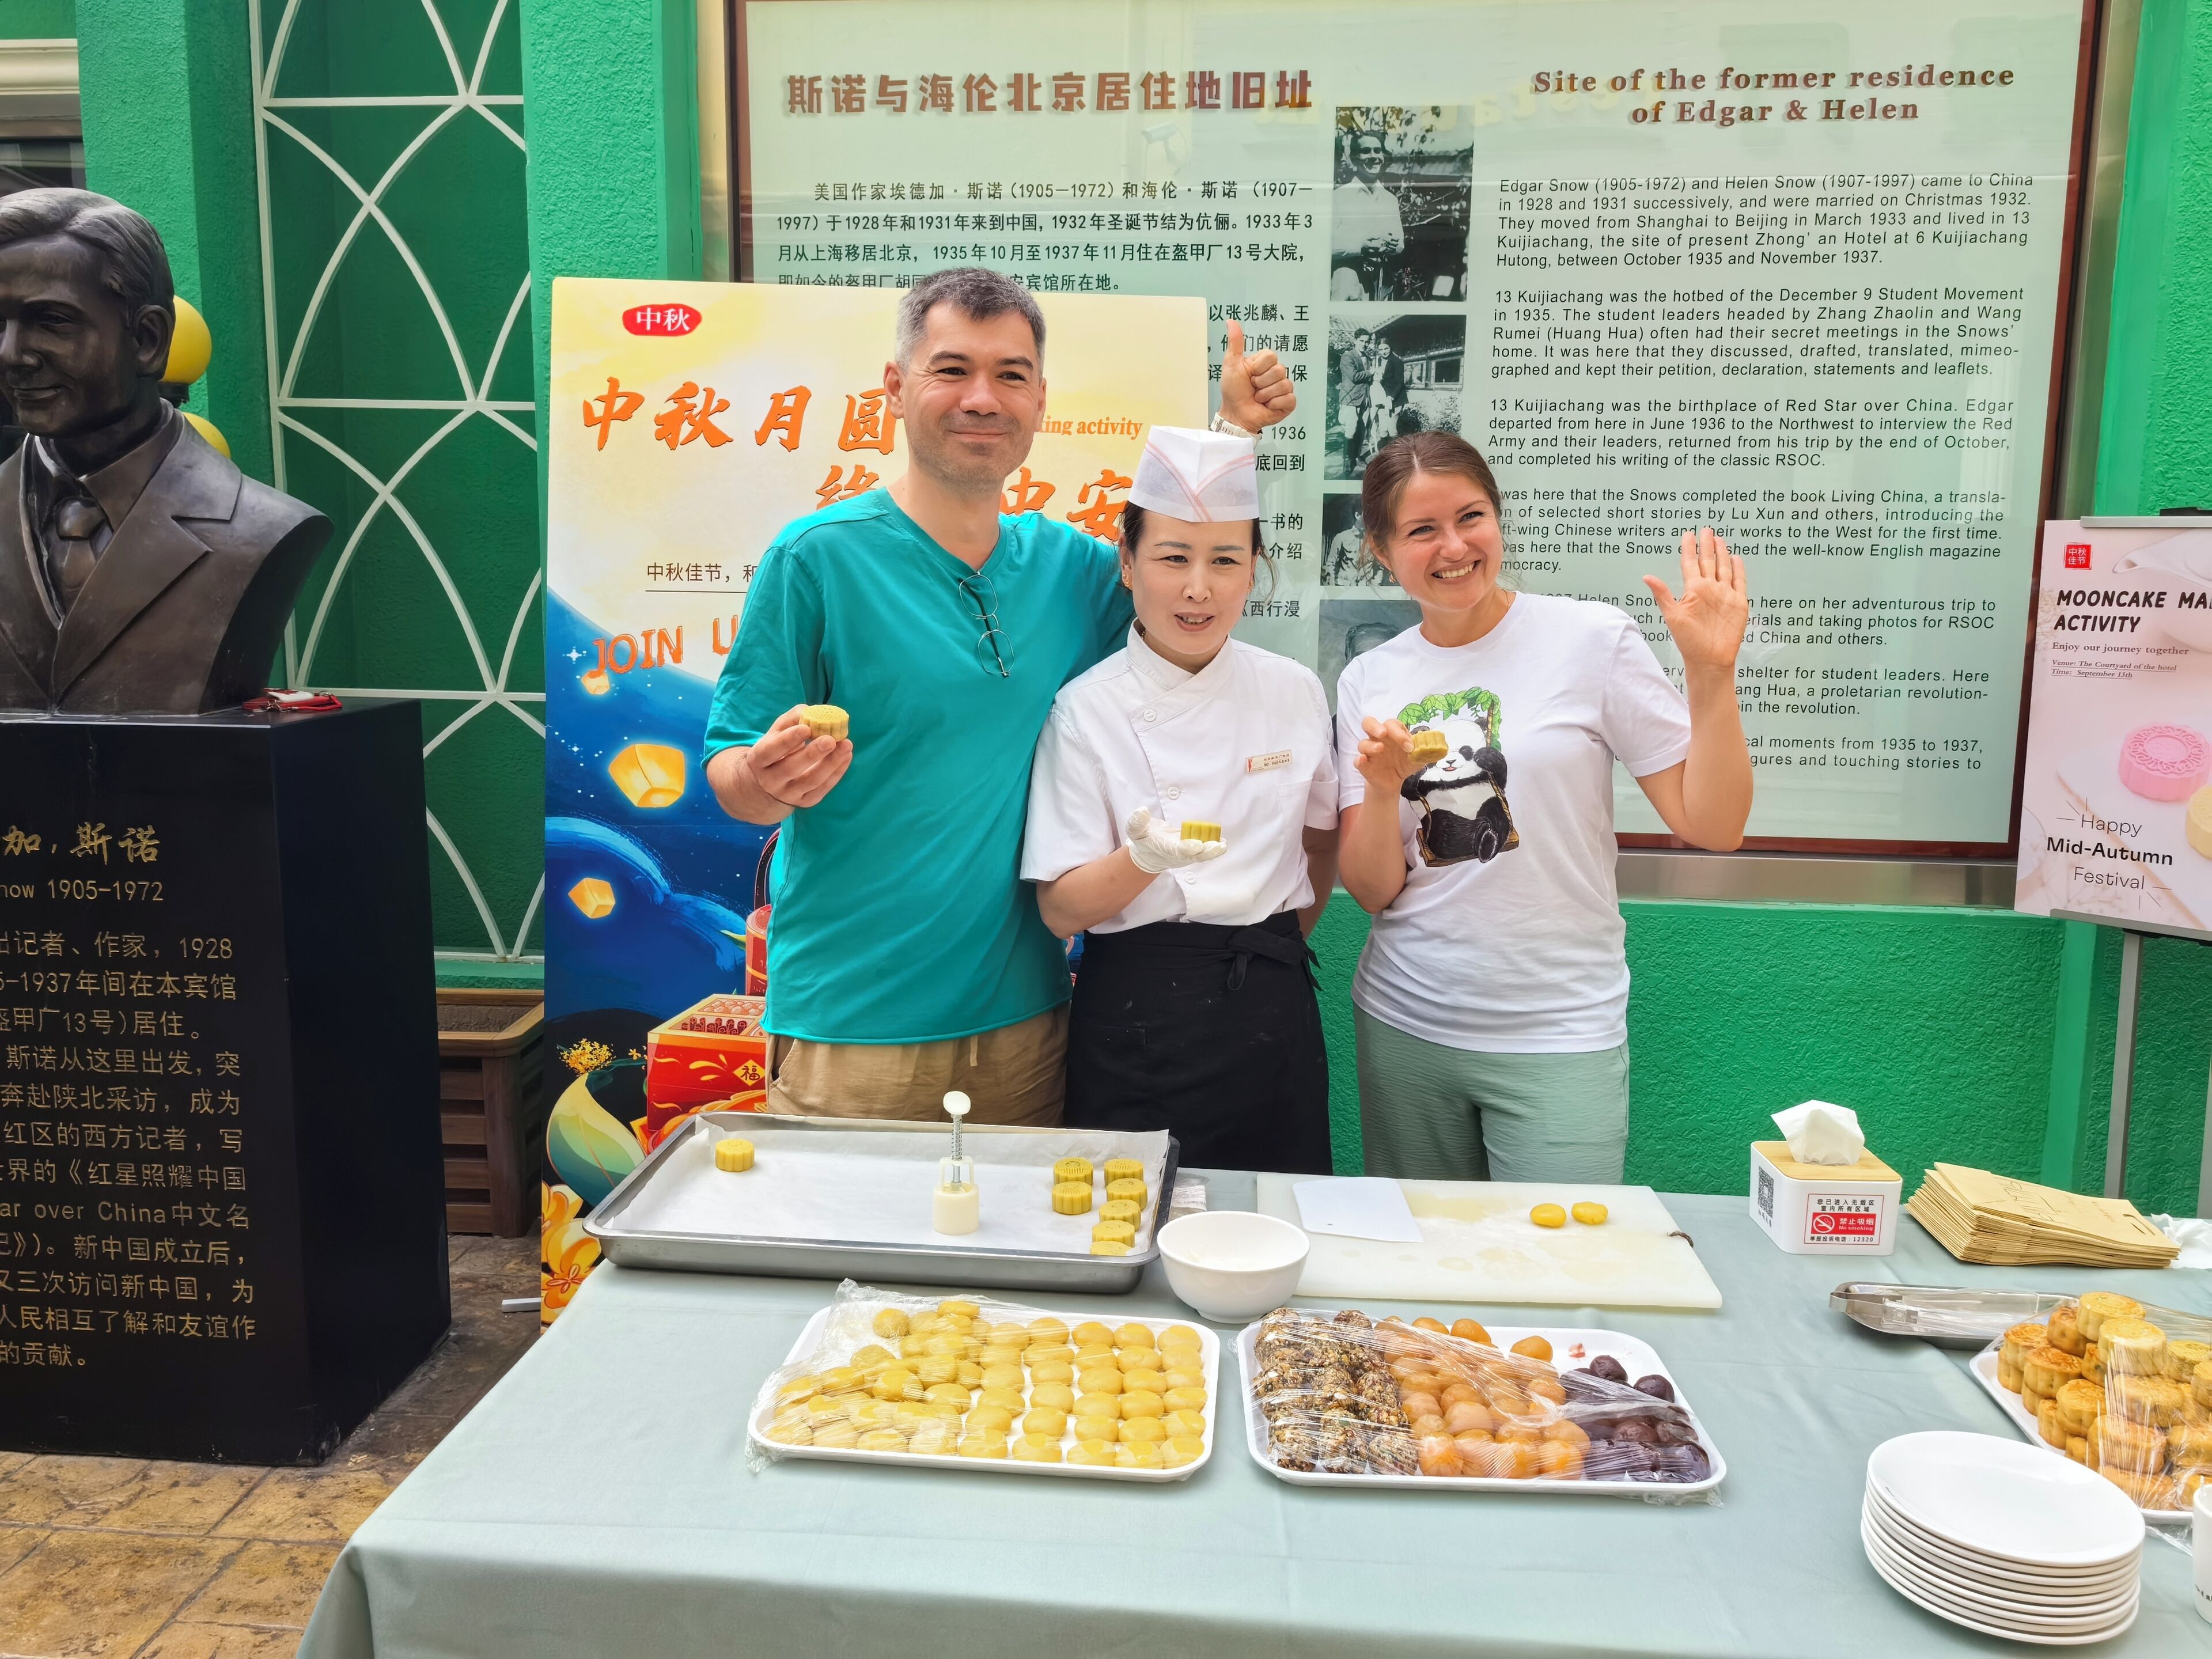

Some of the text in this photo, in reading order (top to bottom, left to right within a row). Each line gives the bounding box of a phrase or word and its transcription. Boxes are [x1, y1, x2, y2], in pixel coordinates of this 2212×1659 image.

[1535, 64, 2013, 92] Site of the former residence
[788, 70, 1312, 113] 斯诺与海伦北京居住地旧址
[1633, 101, 1665, 123] of
[1676, 100, 1772, 127] Edgar
[1787, 100, 1807, 120] &
[1821, 98, 1918, 119] Helen
[1501, 173, 2032, 195] Edgar Snow (1905-1972) and Helen Snow (1907-1997) came to China
[1499, 192, 2031, 211] in 1928 and 1931 successively, and were married on Christmas 1932.
[1496, 287, 2023, 306] 13 Kuijiachang was the hotbed of the December 9 Student Movement
[635, 305, 691, 332] 中秋
[1491, 399, 2013, 414] 13 Kuijiachang was the birthplace of Red Star over China. Edgar
[1077, 416, 1143, 441] activity
[1272, 426, 1306, 440] 1936
[1256, 454, 1305, 471] 底回到
[1534, 488, 1564, 500] here
[1570, 488, 1597, 500] that
[1603, 488, 1624, 501] the
[1630, 489, 1676, 501] Snows
[1683, 489, 1756, 504] completed
[1763, 490, 1785, 502] the
[1791, 490, 1825, 502] book
[1832, 490, 1874, 505] Living
[1881, 490, 1927, 504] China,
[1934, 493, 1942, 502] a
[1949, 491, 2006, 503] transla-
[1269, 542, 1302, 560] 介绍
[1761, 596, 1995, 613] here on her adventurous trip to
[2056, 590, 2212, 609] MOONCAKE MA
[2054, 614, 2141, 633] ACTIVITY
[587, 625, 684, 678] JOIN
[2052, 642, 2080, 653] Enjoy
[2102, 644, 2142, 655] journey
[2146, 647, 2190, 656] together
[1738, 666, 1988, 681] shelter for student leaders. Here
[2077, 670, 2115, 678] September
[2095, 661, 2132, 670] Courtyard
[1770, 737, 1982, 753] moments from 1935 to 1937,
[2080, 813, 2142, 837] Happy
[2047, 836, 2173, 866] Mid-Autumn
[2073, 866, 2146, 891] Festival
[48, 881, 164, 900] 1905-1972
[740, 1065, 760, 1081] 福
[35, 1204, 84, 1219] over
